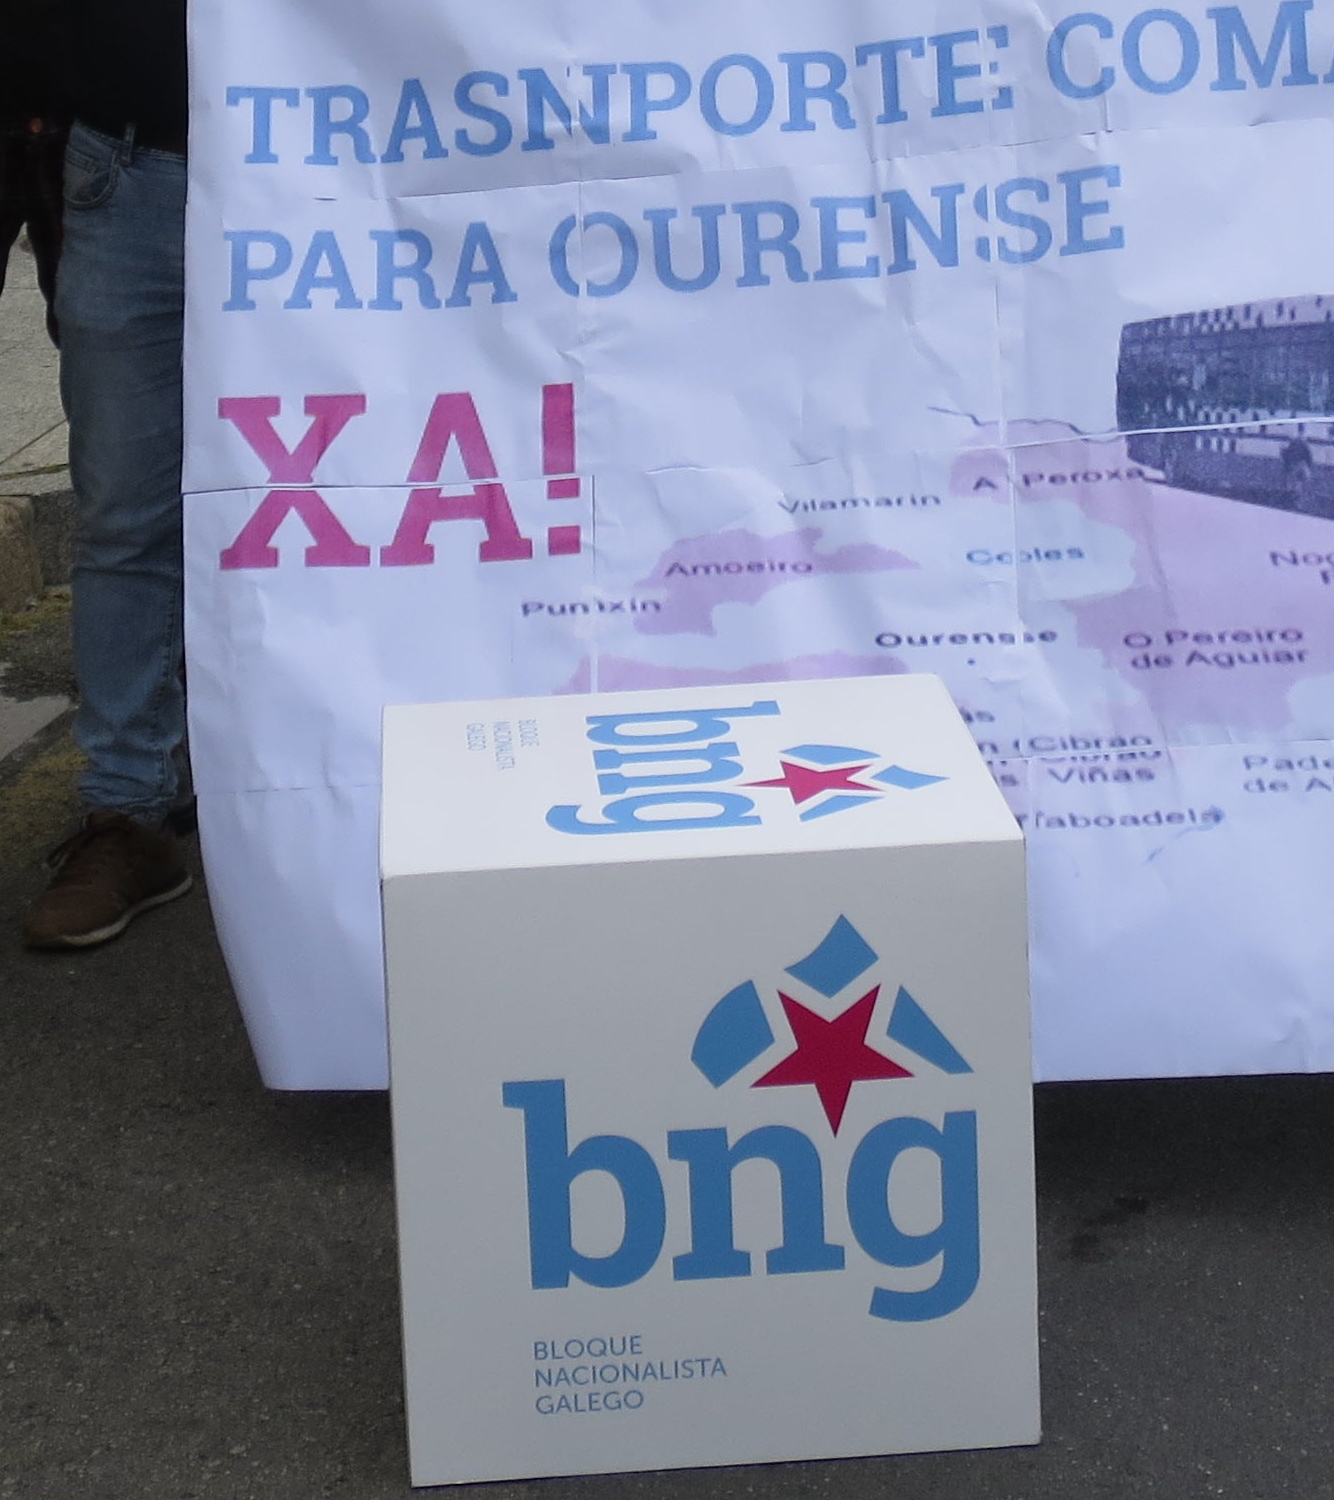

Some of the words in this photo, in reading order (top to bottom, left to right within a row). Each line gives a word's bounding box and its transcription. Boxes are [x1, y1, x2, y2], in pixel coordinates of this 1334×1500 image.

[225, 24, 1014, 167] TRASNPORTE
[221, 221, 518, 312] PARA
[548, 164, 1126, 299] OURENSE
[217, 382, 582, 572] XA!
[972, 474, 998, 492] A
[664, 560, 814, 578] Amoeiro
[1123, 631, 1153, 649] O
[1130, 650, 1173, 670] de
[1184, 647, 1309, 669] Aguiar
[545, 699, 782, 836] bng
[501, 1077, 982, 1323] bng
[532, 1334, 643, 1363] BLOQUE
[533, 1356, 729, 1390] NACIONALISTA
[534, 1389, 645, 1416] GALEGO
